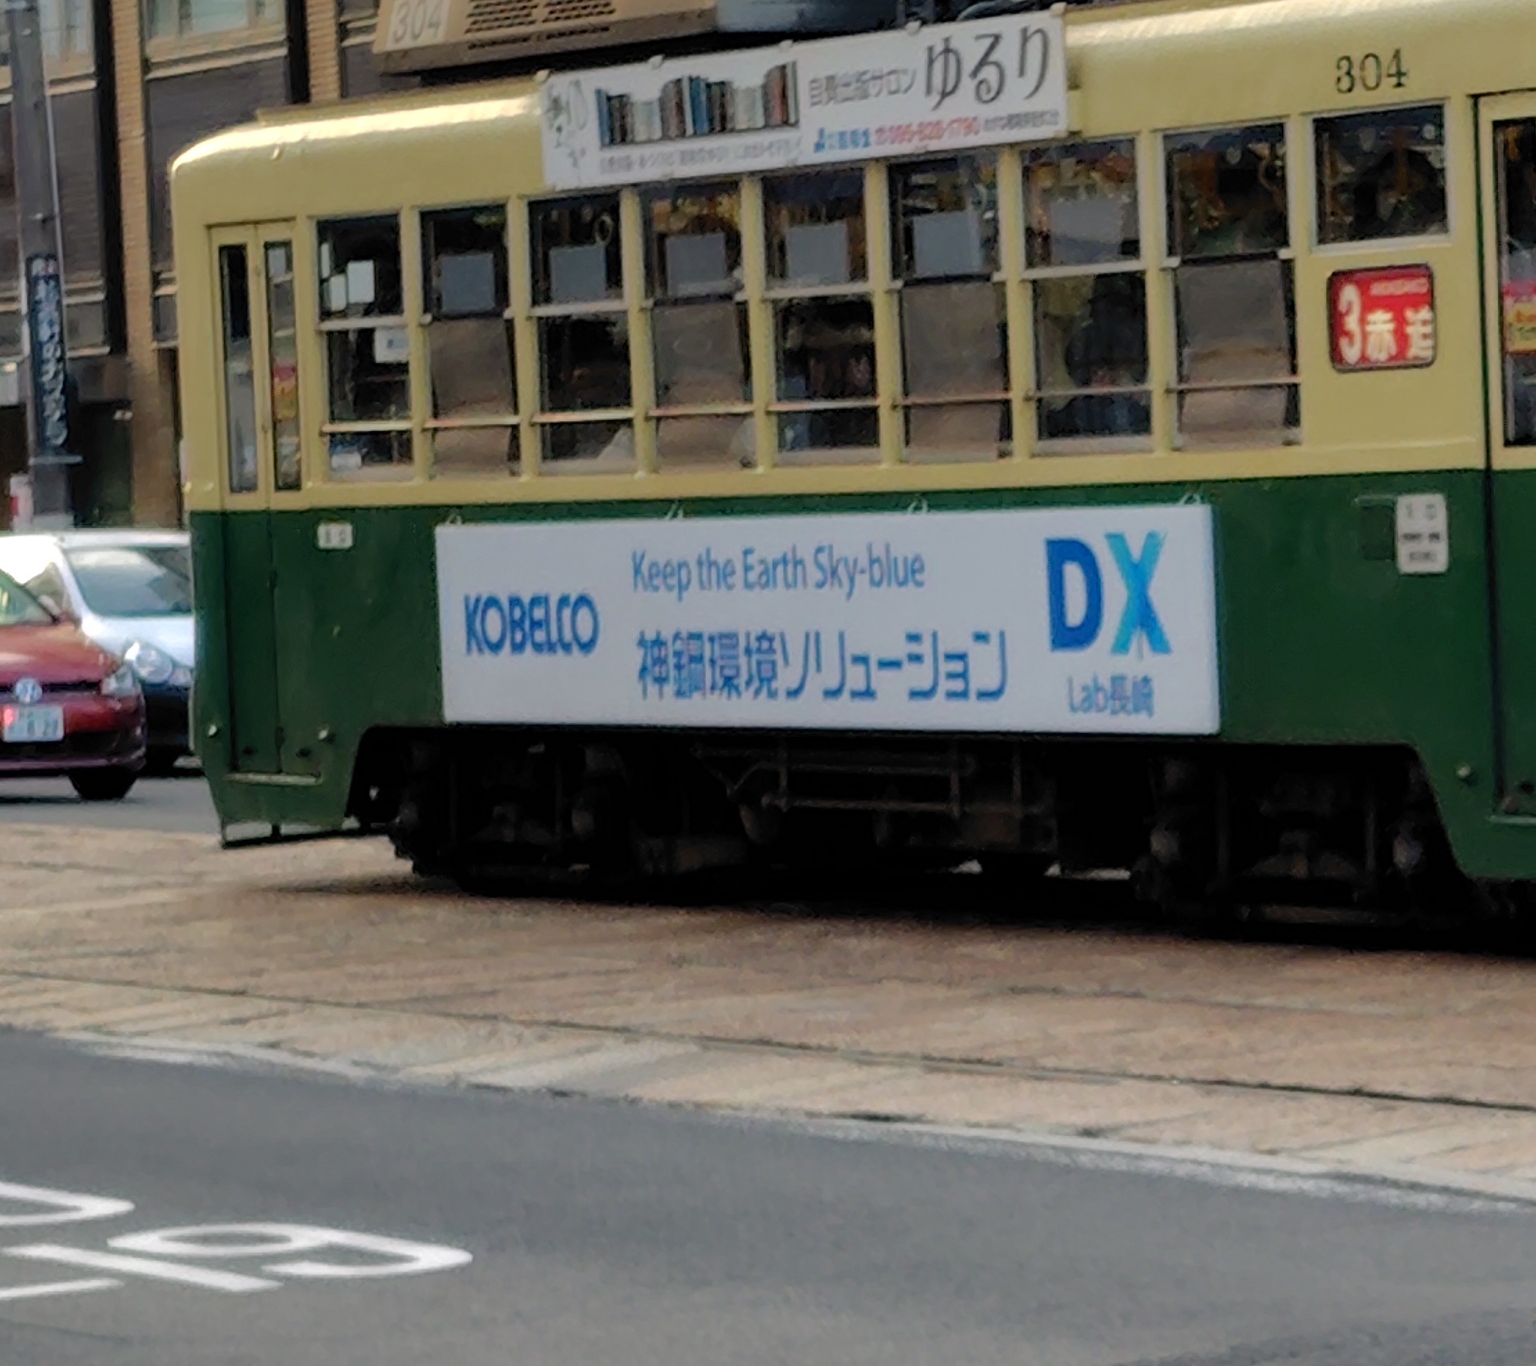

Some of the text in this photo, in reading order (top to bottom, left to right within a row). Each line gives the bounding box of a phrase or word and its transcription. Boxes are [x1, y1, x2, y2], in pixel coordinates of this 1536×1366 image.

[924, 24, 1050, 111] ゆるり
[1336, 47, 1408, 93] 304
[1338, 283, 1362, 364] 3
[632, 542, 926, 602] Keep the Earth Sky-blue
[1044, 530, 1172, 655] DX
[464, 592, 600, 657] KOBELCO
[636, 629, 1009, 702] 神鋼環境ソリューション
[1066, 673, 1155, 718] Lab長崎
